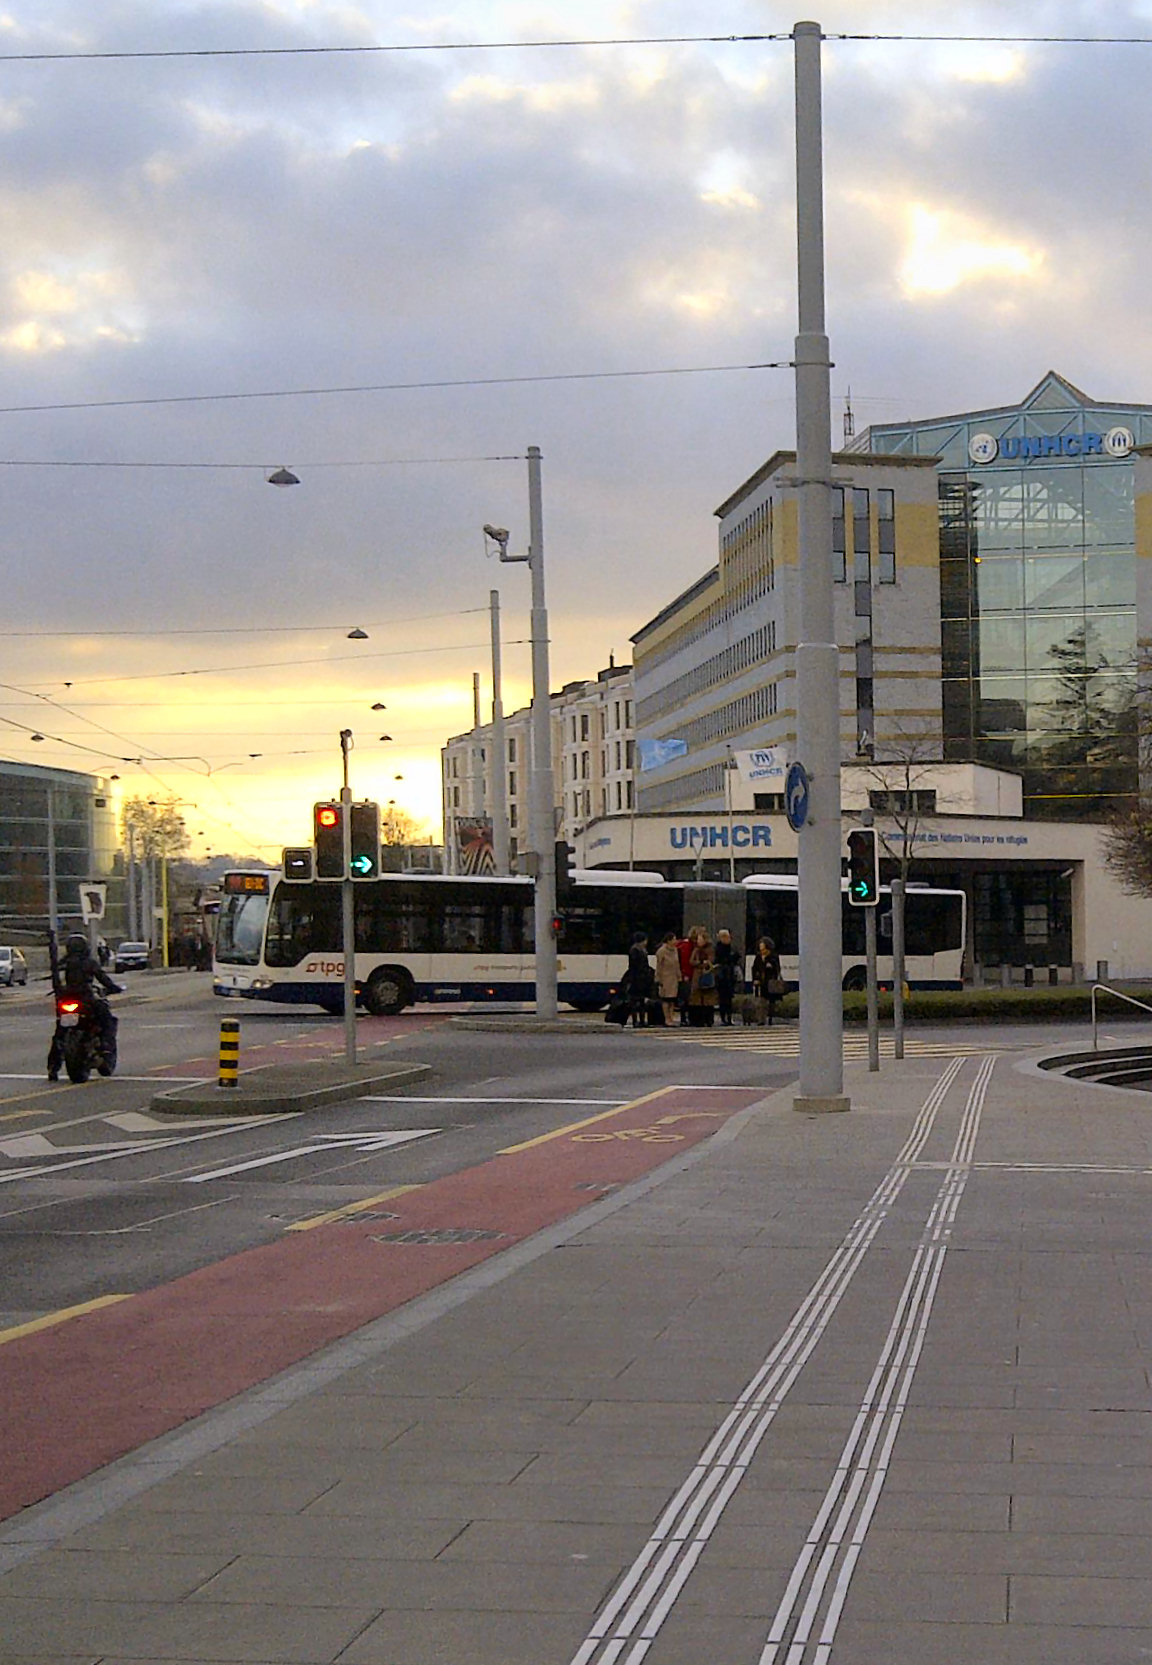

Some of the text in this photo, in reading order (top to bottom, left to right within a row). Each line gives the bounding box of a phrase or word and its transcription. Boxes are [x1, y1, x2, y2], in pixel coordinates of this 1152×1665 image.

[1000, 433, 1101, 459] UNHCR
[749, 767, 783, 778] UNHCR
[670, 825, 772, 849] UNHCR
[320, 961, 345, 977] tpg
